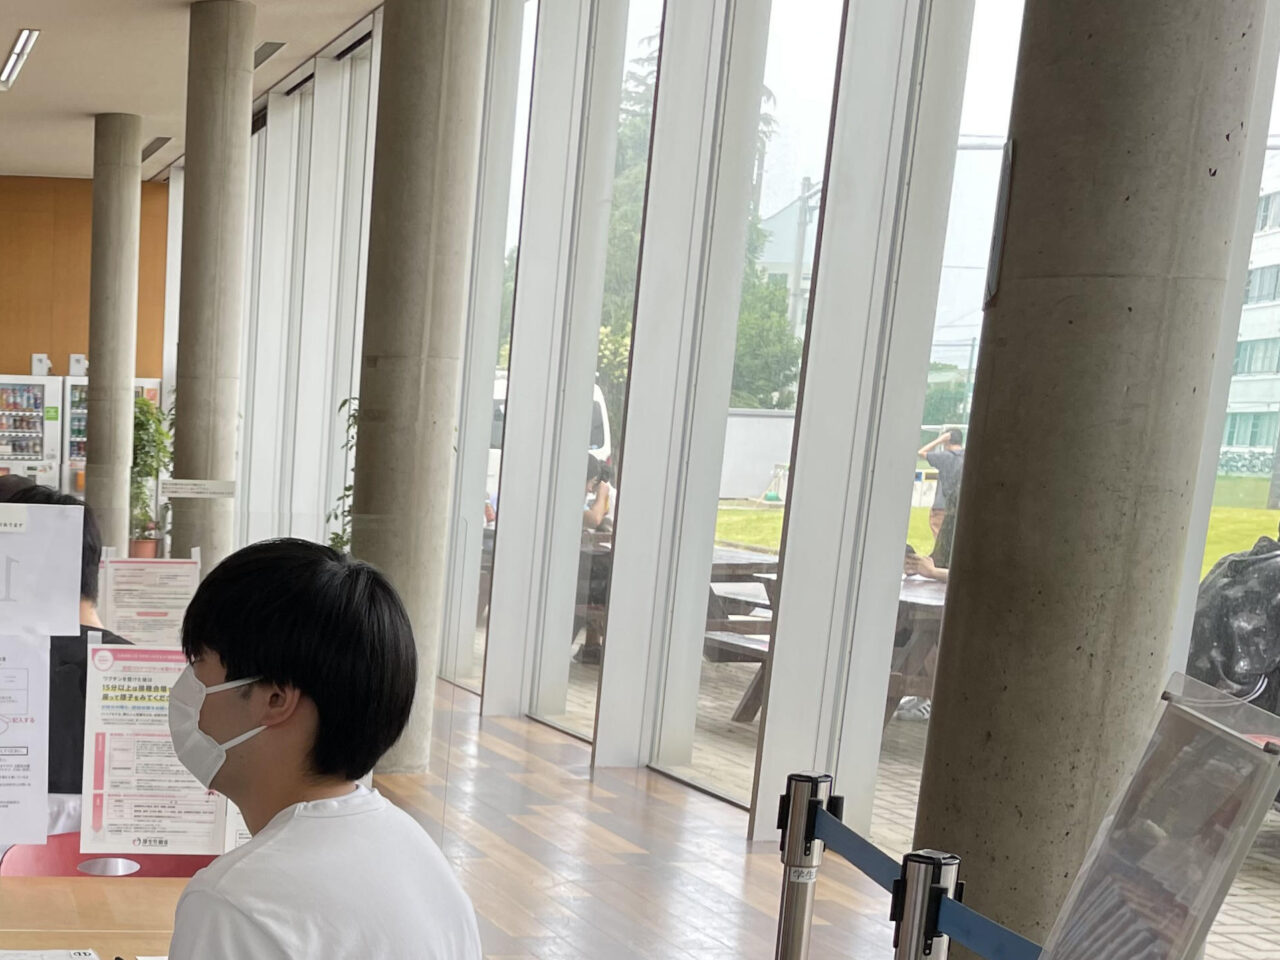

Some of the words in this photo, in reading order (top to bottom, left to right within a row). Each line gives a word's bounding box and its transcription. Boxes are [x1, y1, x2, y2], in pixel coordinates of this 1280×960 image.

[102, 684, 169, 692] 15分以上は接種会場
